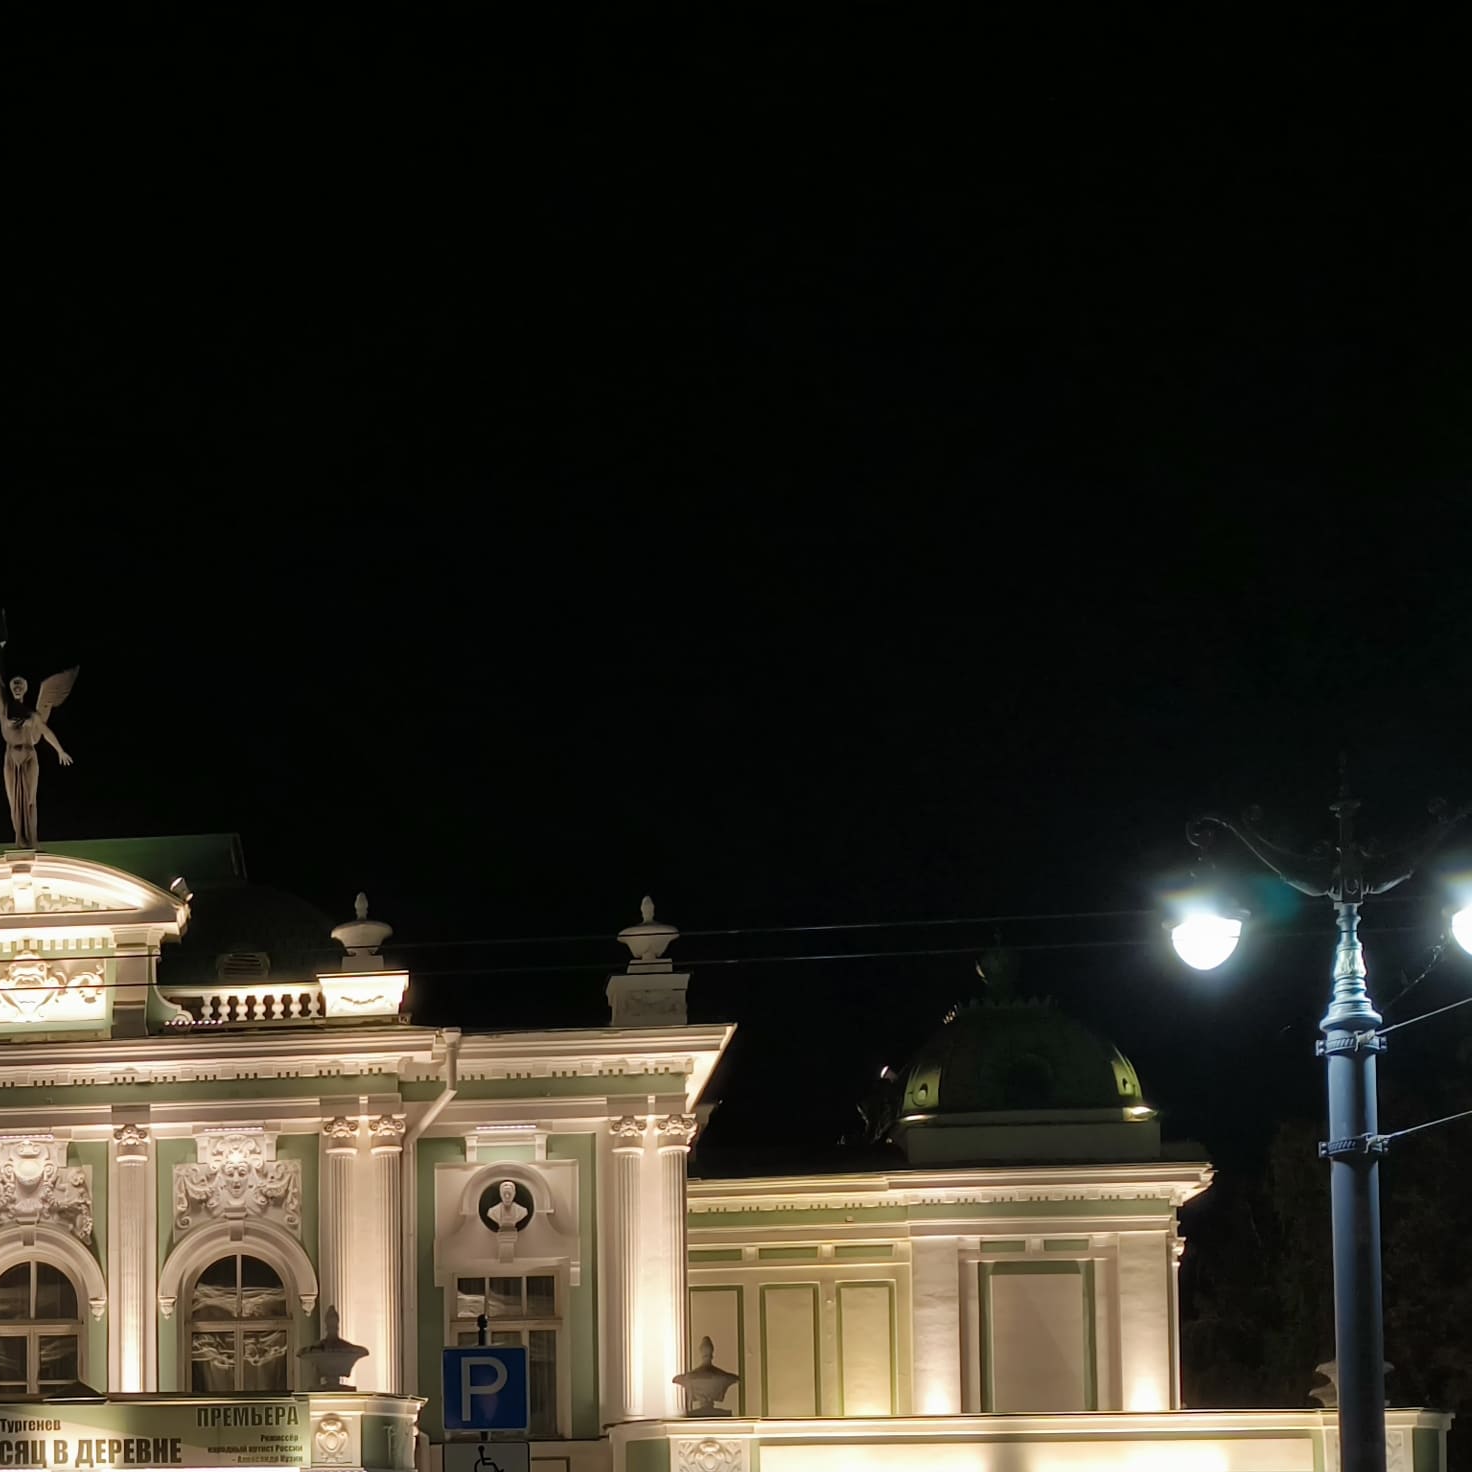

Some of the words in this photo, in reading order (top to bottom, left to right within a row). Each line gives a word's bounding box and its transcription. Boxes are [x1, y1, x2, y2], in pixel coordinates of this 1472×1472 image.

[460, 1356, 508, 1422] P
[0, 1418, 61, 1434] Тургенев
[197, 1405, 299, 1427] ПРЕМЬЕРА
[53, 1439, 69, 1465] В
[74, 1438, 183, 1468] ДЕРЕВНЕ
